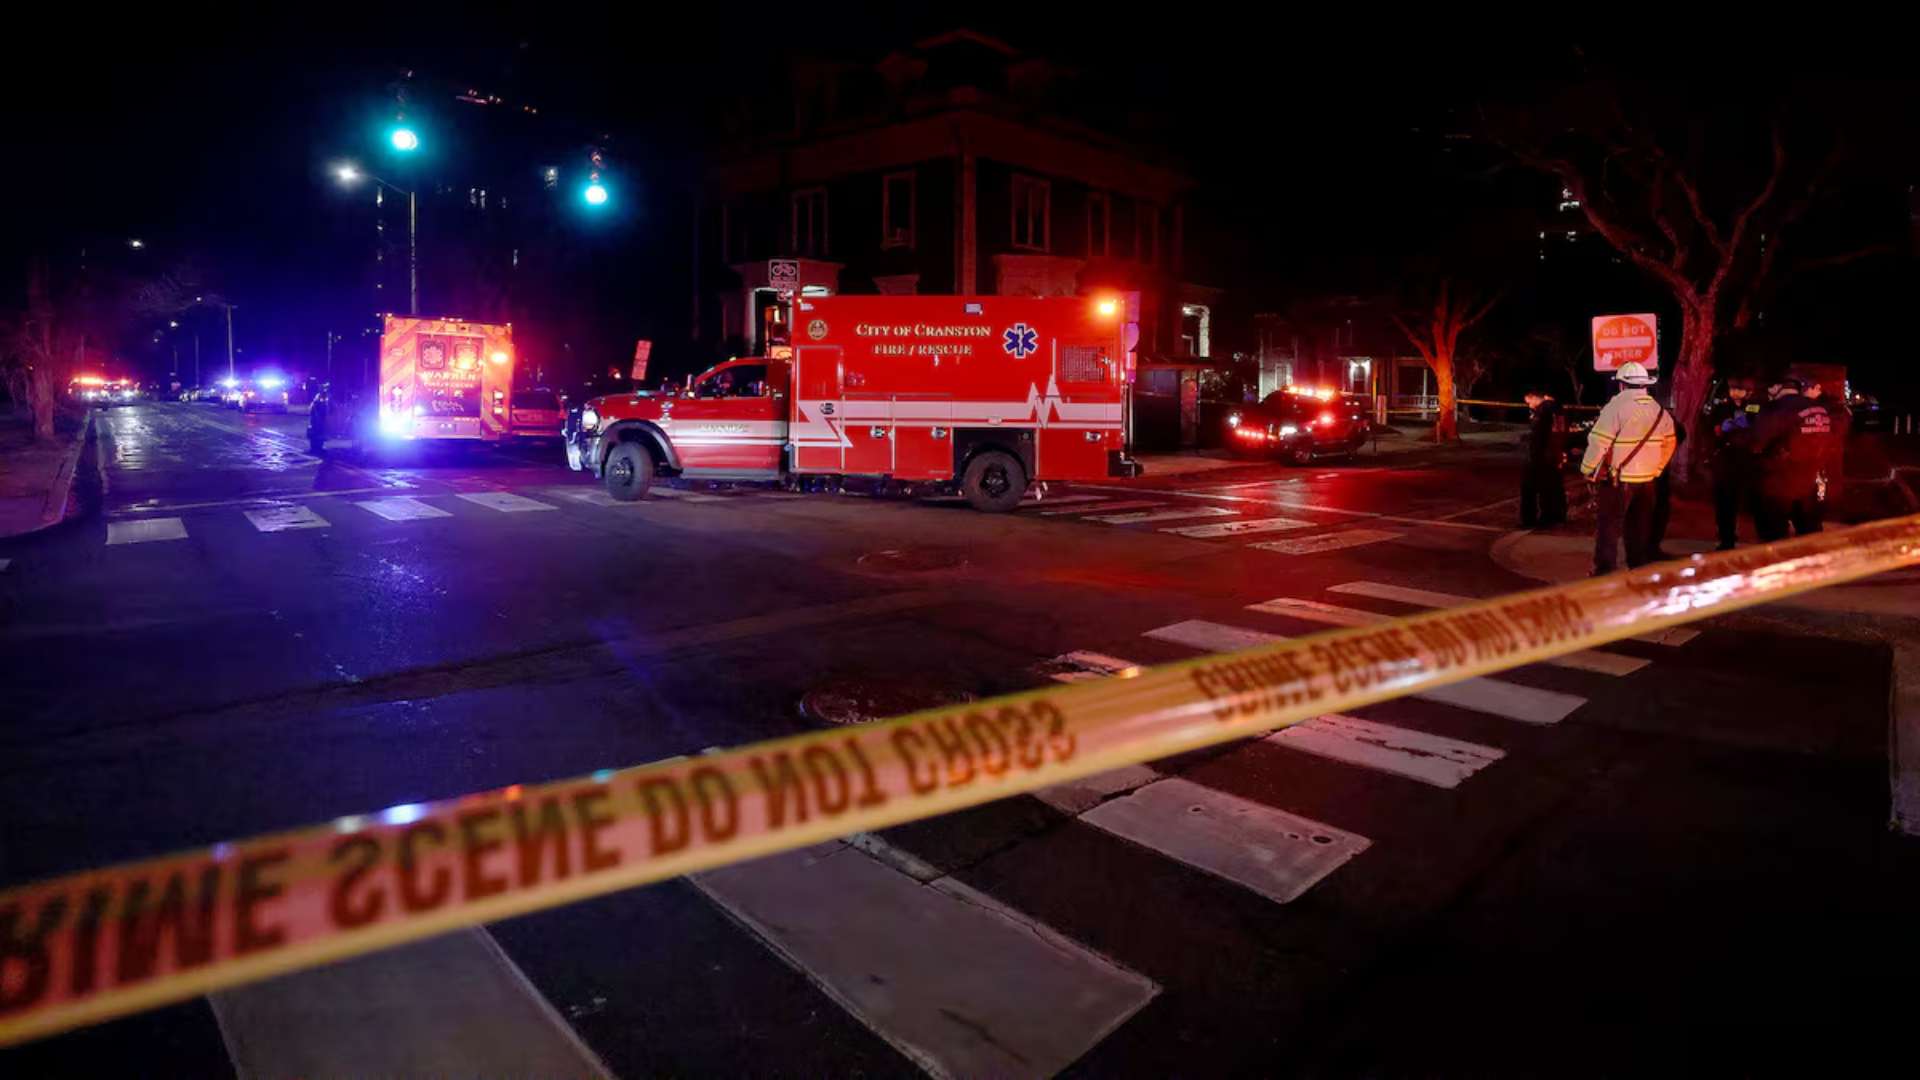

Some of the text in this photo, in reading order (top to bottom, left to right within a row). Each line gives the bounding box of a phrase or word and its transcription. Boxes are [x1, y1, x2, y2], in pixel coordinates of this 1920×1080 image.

[893, 325, 912, 337] OF
[873, 344, 905, 355] FIRE
[918, 344, 972, 356] RESCUE
